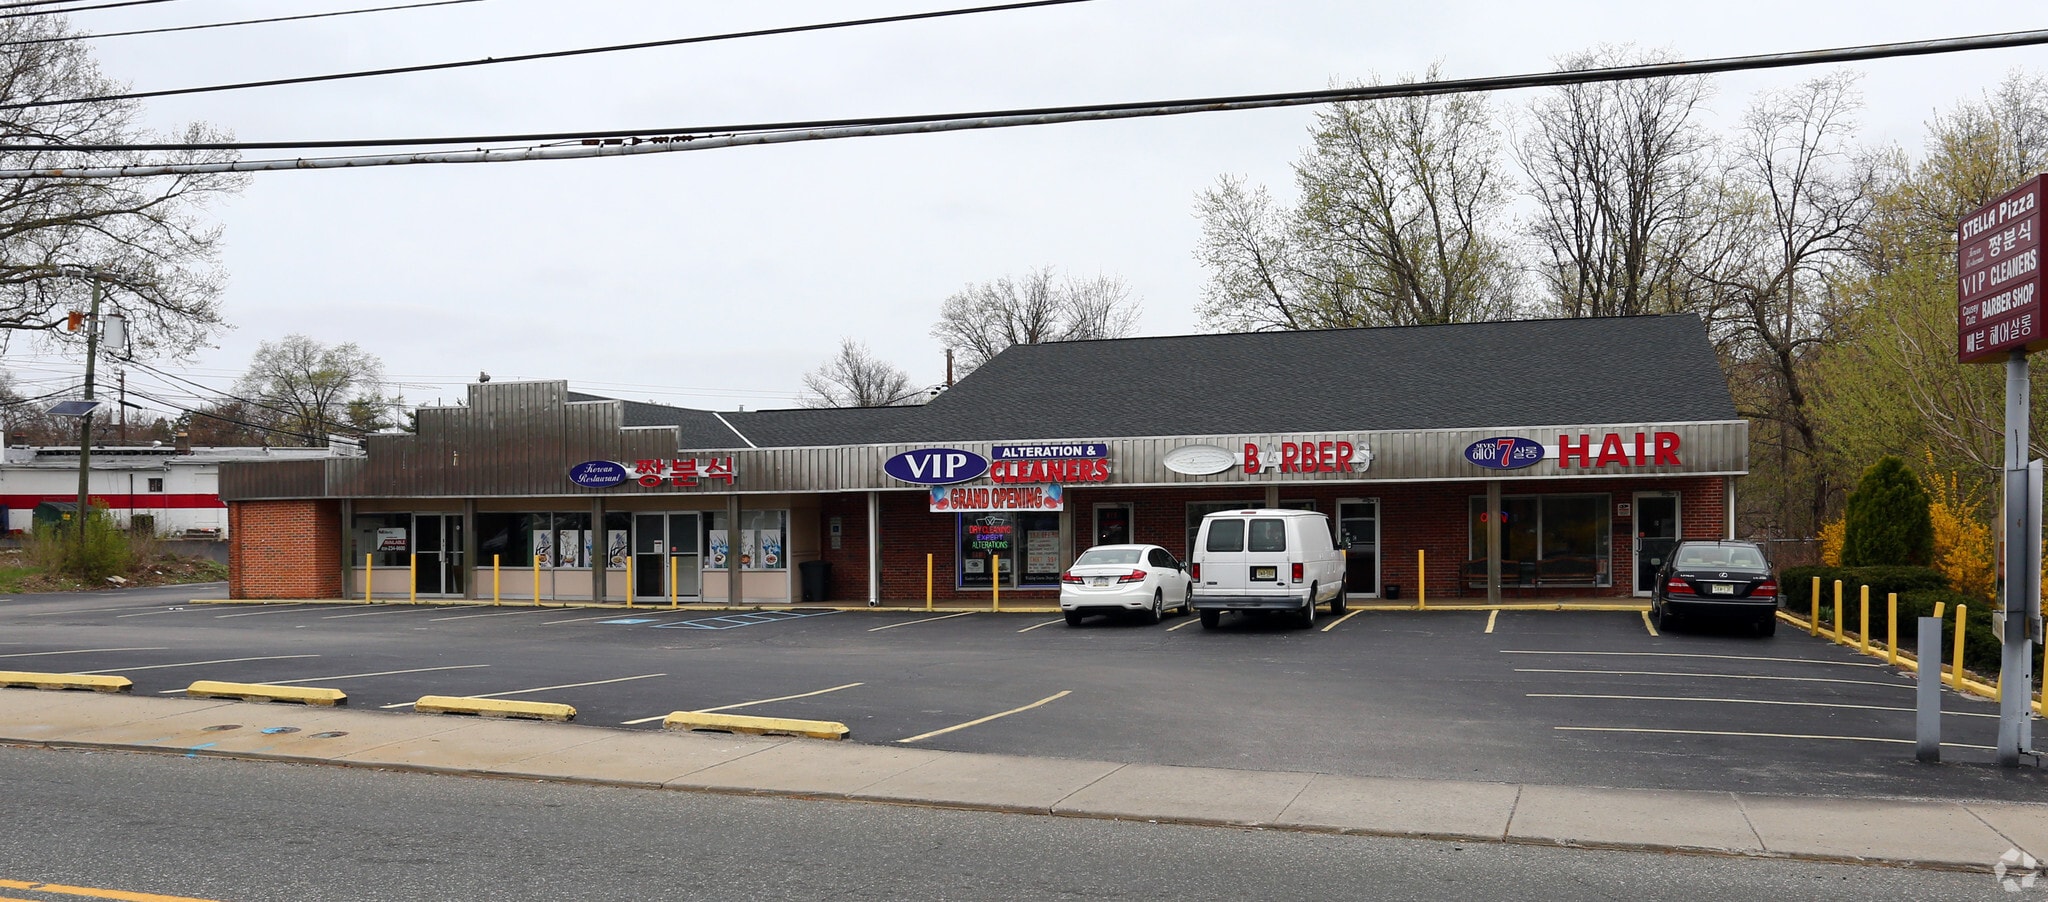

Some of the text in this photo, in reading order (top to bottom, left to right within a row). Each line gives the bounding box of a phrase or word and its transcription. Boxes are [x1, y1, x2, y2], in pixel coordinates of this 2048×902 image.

[1963, 192, 2035, 241] STELLA Pizza
[1988, 219, 2031, 257] 짱분식
[1963, 270, 1986, 297] VIP
[1990, 248, 2037, 286] CLEANERS
[1982, 282, 2034, 319] BARBER SHOP
[1989, 314, 2032, 345] 헤어살롱
[1002, 445, 1097, 458] ALTERATION &
[1244, 440, 1371, 474] BARBERS
[1472, 438, 1538, 467] 헤어 7 살롱
[1558, 432, 1681, 468] HAIR
[577, 473, 621, 483] Restaurant
[584, 463, 613, 473] Korean
[634, 456, 735, 488] 짱분식
[904, 453, 967, 479] VIP
[989, 457, 1110, 484] CLEANERS
[950, 486, 1043, 510] GRAND OPENING
[969, 525, 1012, 534] DRY CLEANING
[972, 540, 1008, 549] ALTERATIONS
